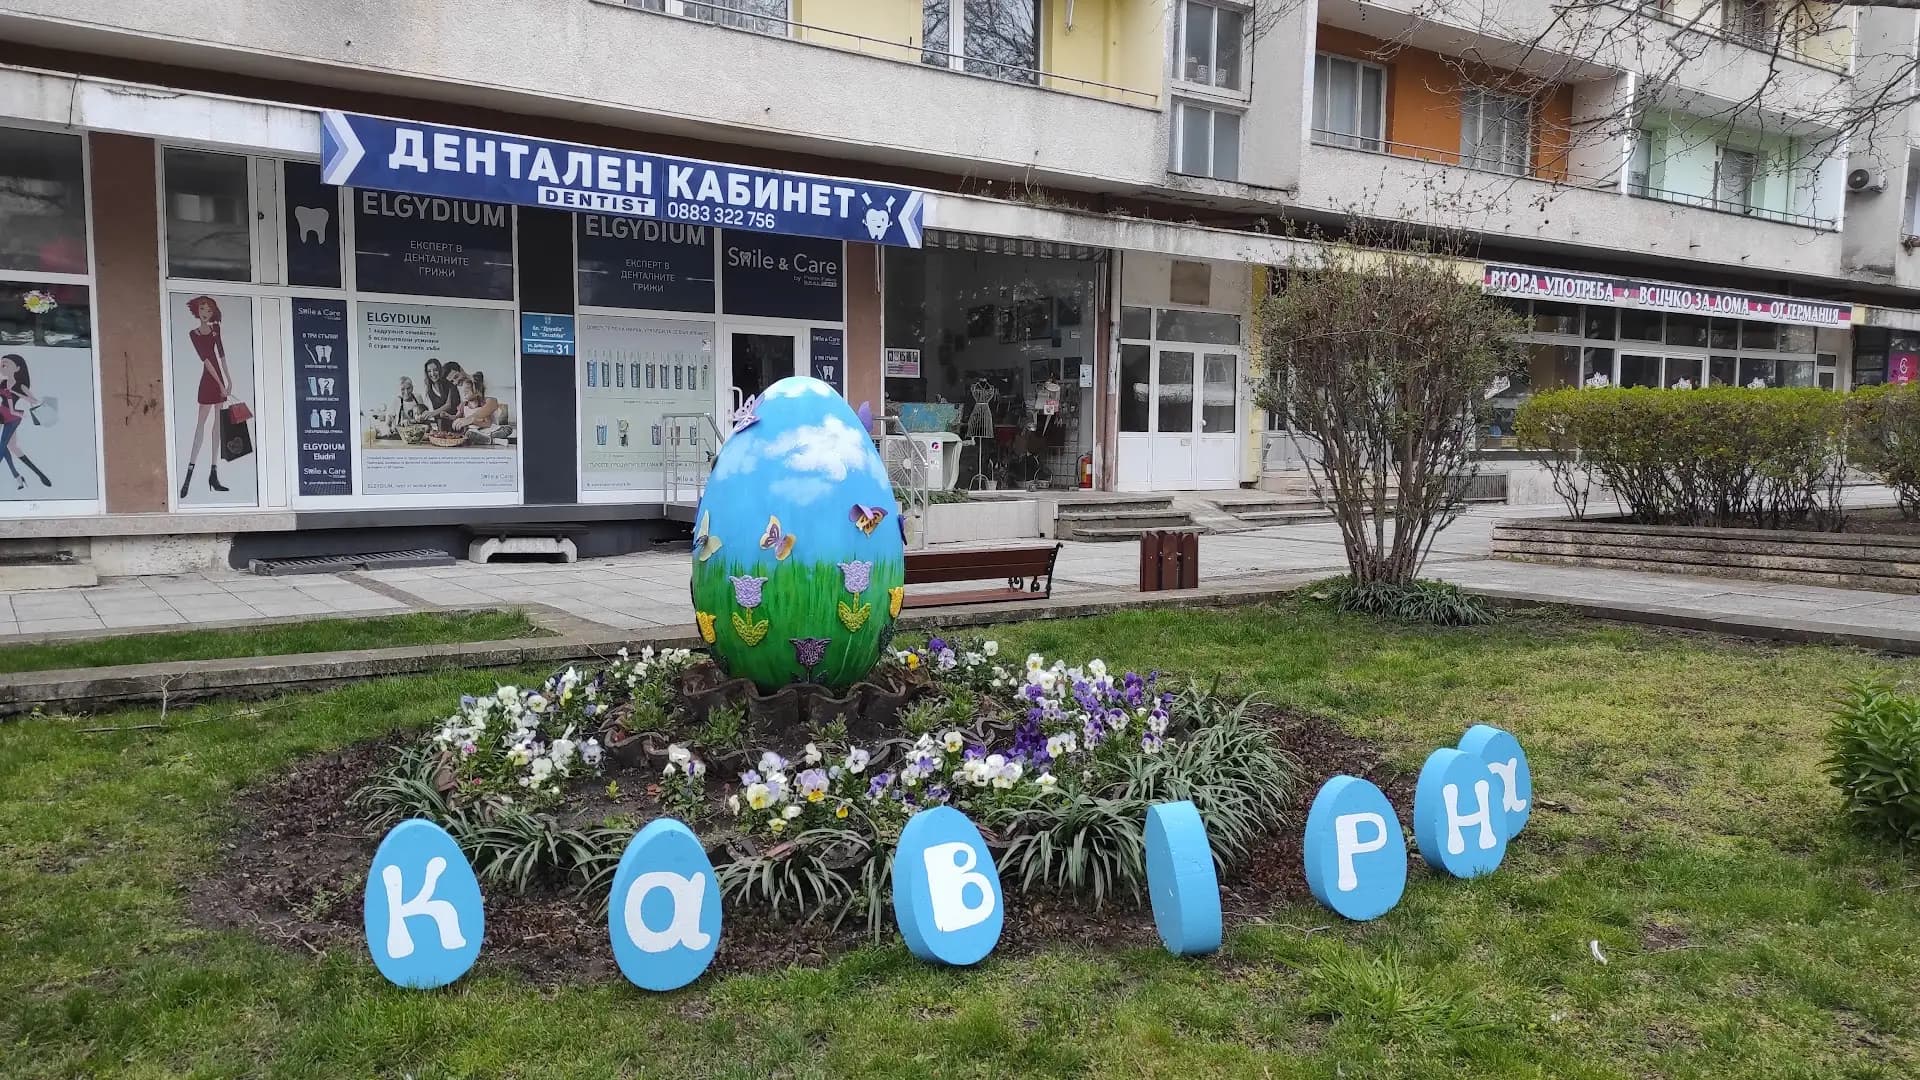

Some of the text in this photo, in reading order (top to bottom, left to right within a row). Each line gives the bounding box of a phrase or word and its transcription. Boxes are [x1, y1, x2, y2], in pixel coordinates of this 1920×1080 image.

[389, 127, 856, 219] ДЕНТАЛЕН КАБИНЕТ
[545, 189, 649, 214] DENTIST
[363, 191, 505, 228] ELGYDIUM
[667, 201, 776, 229] 0883 322 756
[585, 214, 705, 246] ELGYDIUM
[410, 241, 463, 254] ЕКСПЕРТ В
[403, 253, 470, 266] ДЕНТАЛНИТЕ
[625, 259, 671, 271] ЕКСПЕРТ В
[728, 246, 837, 275] Smile & Care
[419, 267, 456, 278] ГРИЖИ
[620, 271, 676, 283] ДЕНТАЛНИТЕ
[633, 283, 664, 293] ГРИЖИ
[1490, 270, 1841, 326] ВТОРА УПОТРЕБА ВСИЧКО ЗА ДОМА ОТ ГЕРМАНИЯ
[366, 311, 431, 325] ELGYDIUM
[556, 344, 569, 355] 31
[303, 443, 345, 451] ELGYDIUM
[313, 452, 336, 461] Eludril
[382, 856, 467, 959] К
[923, 841, 996, 933] В
[1335, 812, 1388, 891] Р
[1443, 779, 1498, 855] Н
